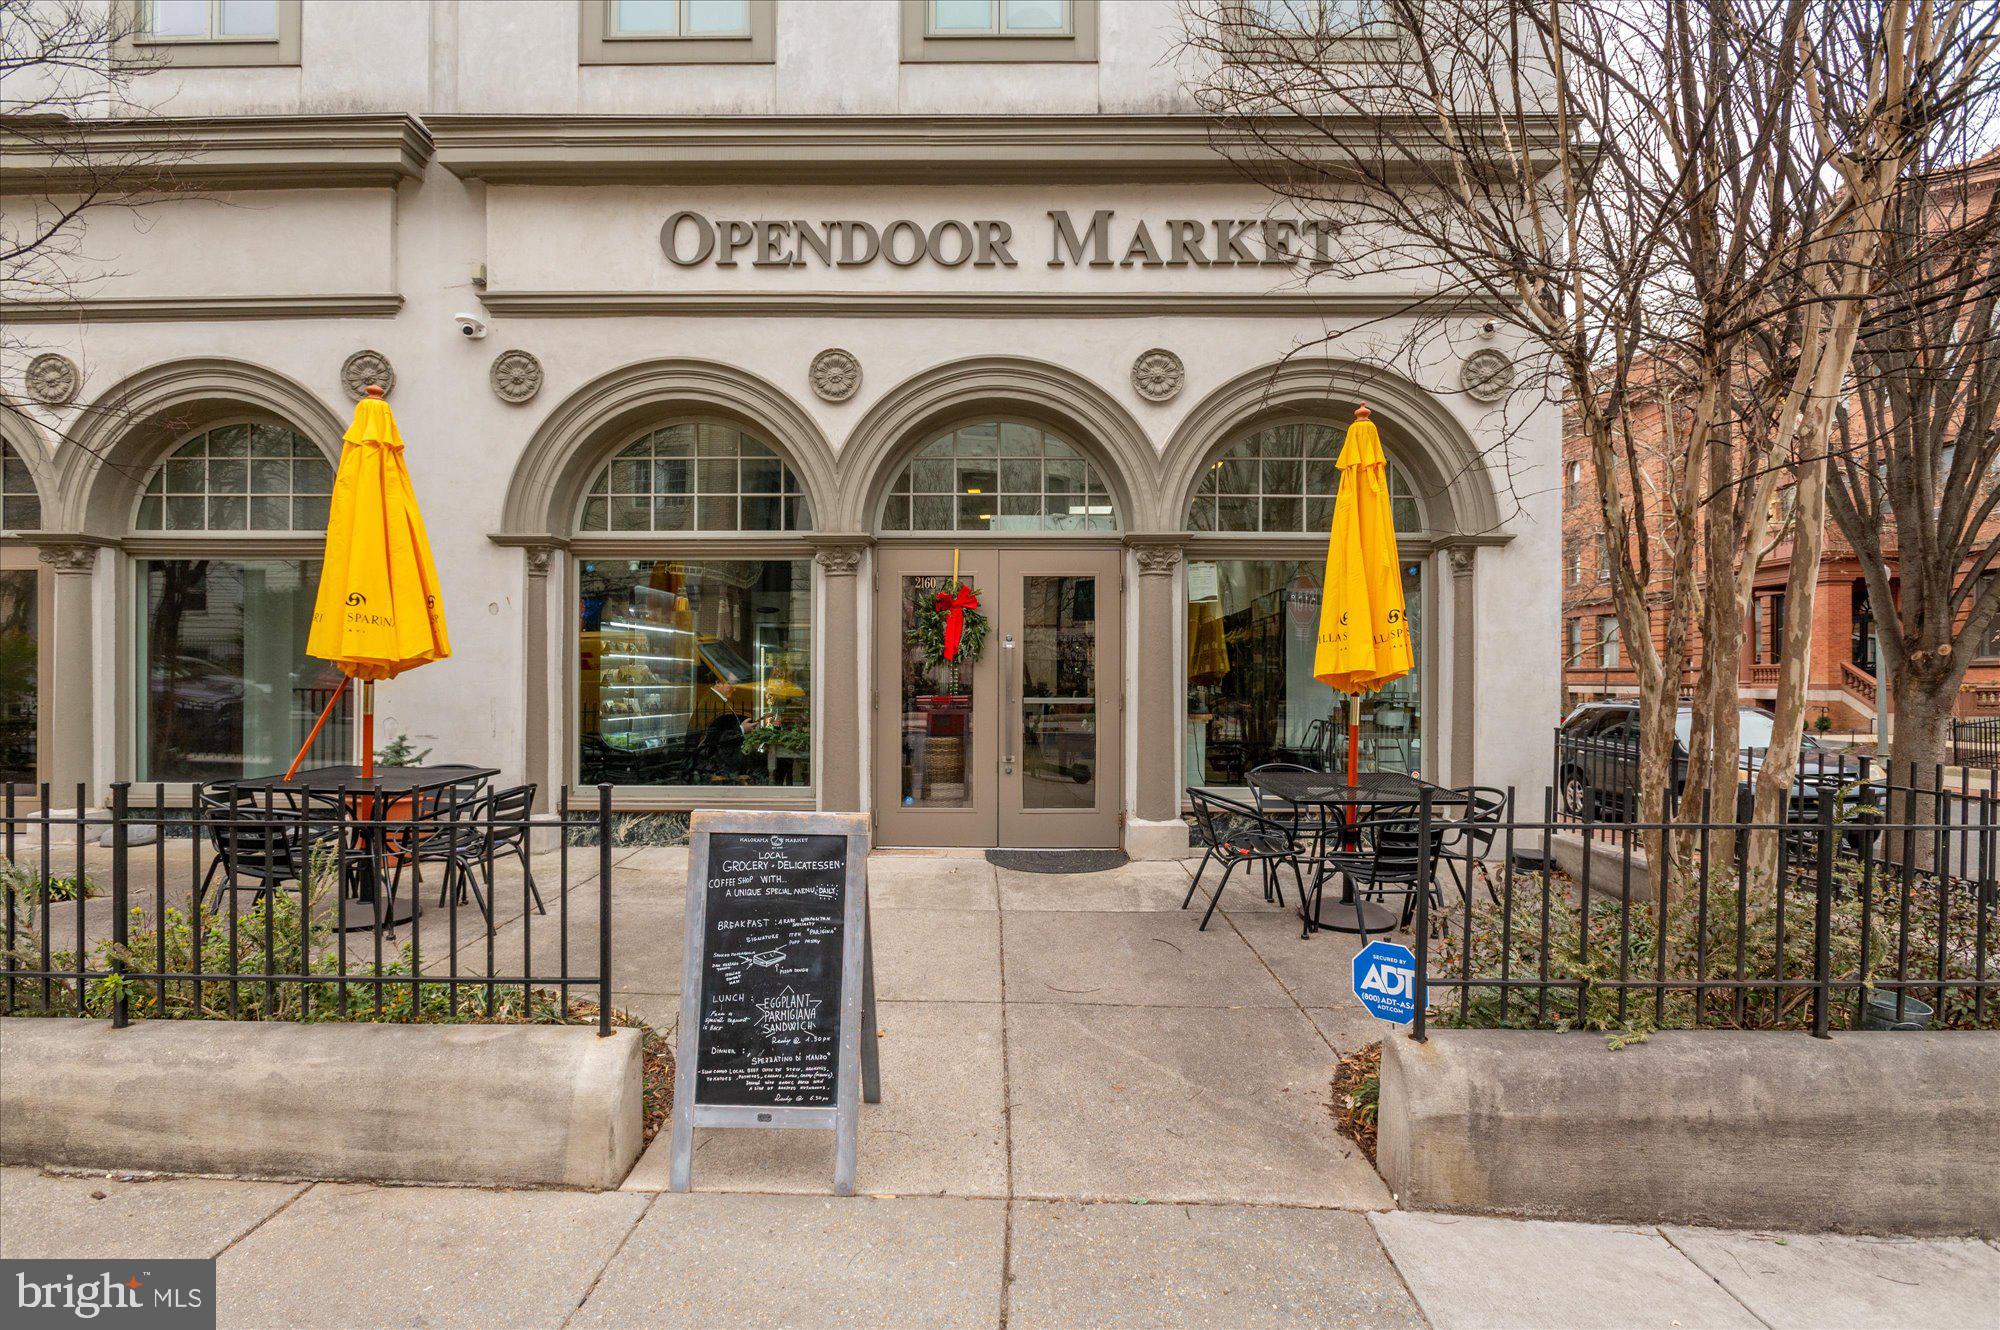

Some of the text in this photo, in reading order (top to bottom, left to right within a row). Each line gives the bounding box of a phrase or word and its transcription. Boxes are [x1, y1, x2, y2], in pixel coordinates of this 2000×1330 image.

[660, 210, 1342, 268] OPENDOOR MARKET
[915, 576, 936, 588] 2160
[347, 612, 396, 628] SPARIN
[722, 860, 840, 872] GROCERY DELICATESSEN
[708, 878, 736, 888] COFFEE
[738, 876, 754, 884] SHOP
[734, 888, 762, 897] UNIQUE
[766, 888, 792, 896] SPECIAL
[718, 918, 770, 930] BREAKFAST
[746, 934, 779, 942] SIGNATURE
[1372, 954, 1398, 963] SECURED
[1360, 962, 1415, 1000] ADT
[712, 994, 744, 1004] LUNCH
[764, 994, 811, 1009] EGGPLANT
[1362, 992, 1414, 1010] (800) ADT-ASA
[764, 1008, 816, 1022] PARMIGIANA
[1378, 1004, 1404, 1014] ADT.COM
[762, 1021, 812, 1034] SANDWICH
